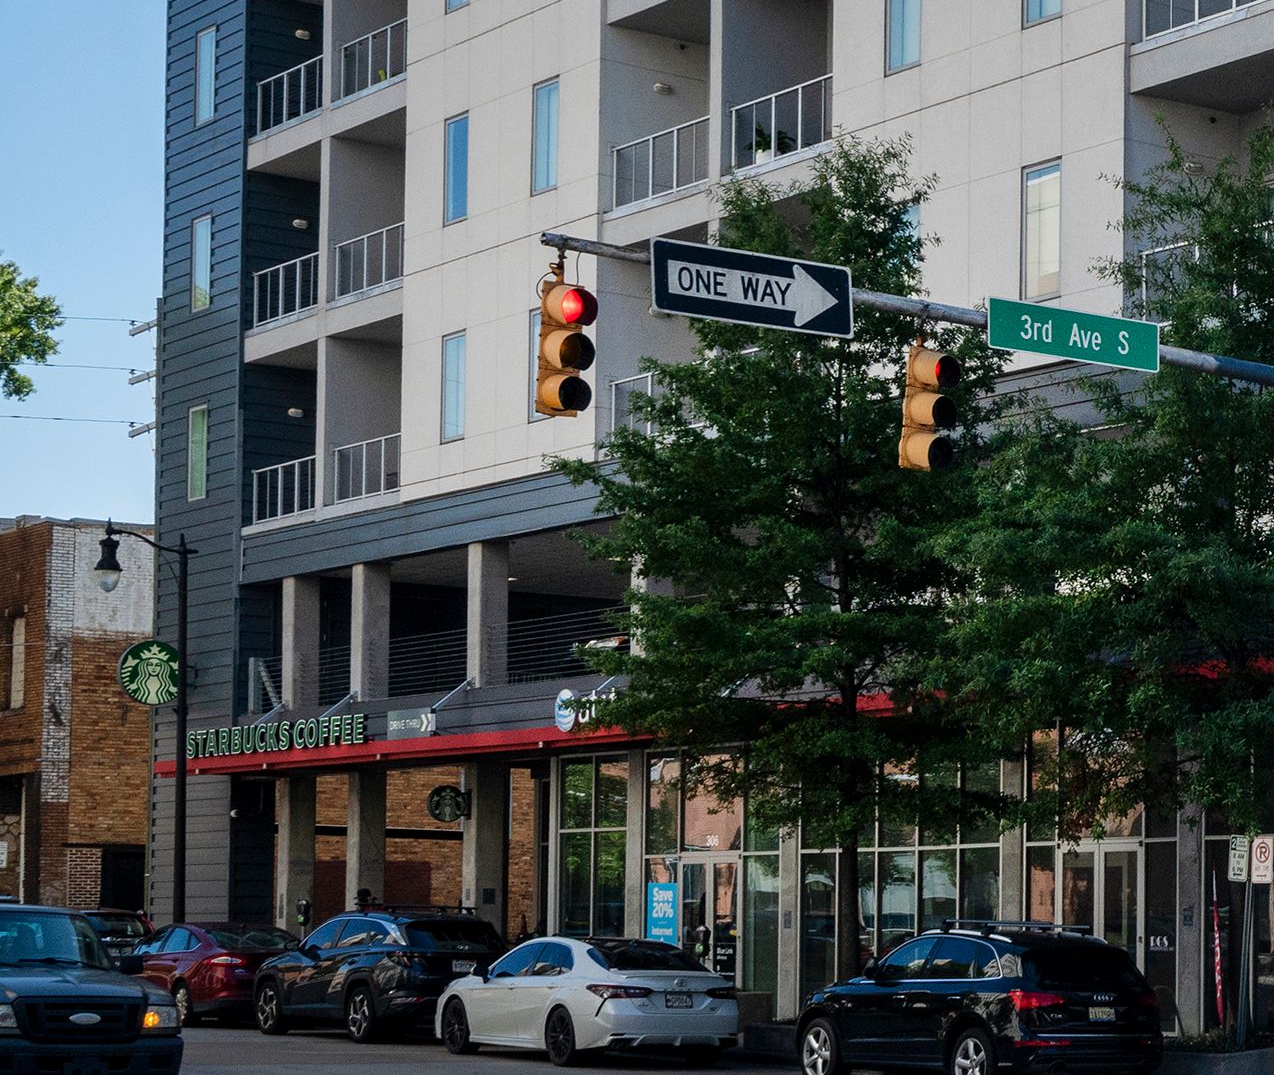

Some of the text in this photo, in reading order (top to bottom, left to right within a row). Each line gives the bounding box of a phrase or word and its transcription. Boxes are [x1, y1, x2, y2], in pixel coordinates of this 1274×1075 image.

[678, 266, 792, 306] ONE WAY
[1019, 314, 1130, 355] 3rd Ave S
[186, 713, 365, 759] STARBUCKS COFFEE
[652, 887, 674, 902] Save
[652, 902, 674, 918] 20%
